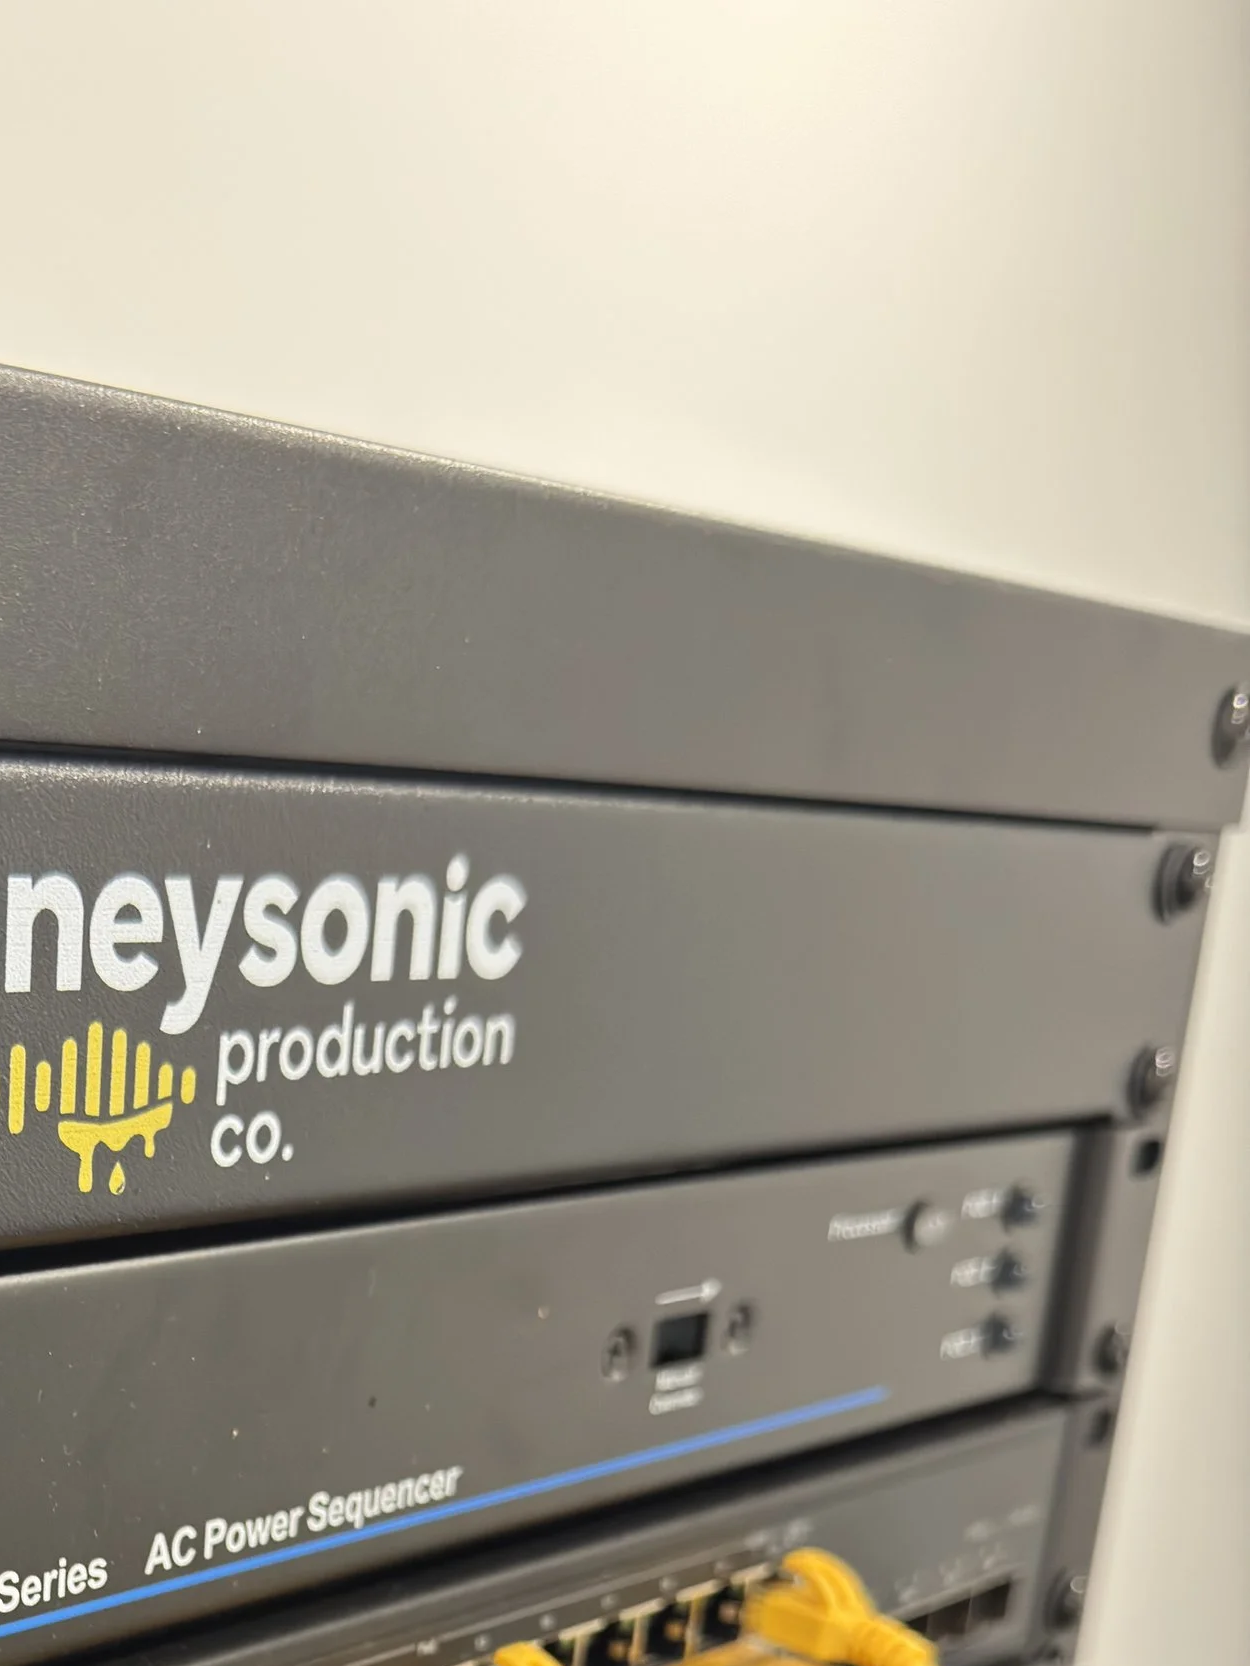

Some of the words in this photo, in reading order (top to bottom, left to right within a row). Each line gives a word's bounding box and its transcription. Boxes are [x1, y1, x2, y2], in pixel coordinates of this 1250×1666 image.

[215, 996, 515, 1106] production
[209, 1112, 294, 1169] co.
[143, 1525, 197, 1575] AC
[203, 1507, 304, 1560] Power
[306, 1465, 464, 1530] Sequencer
